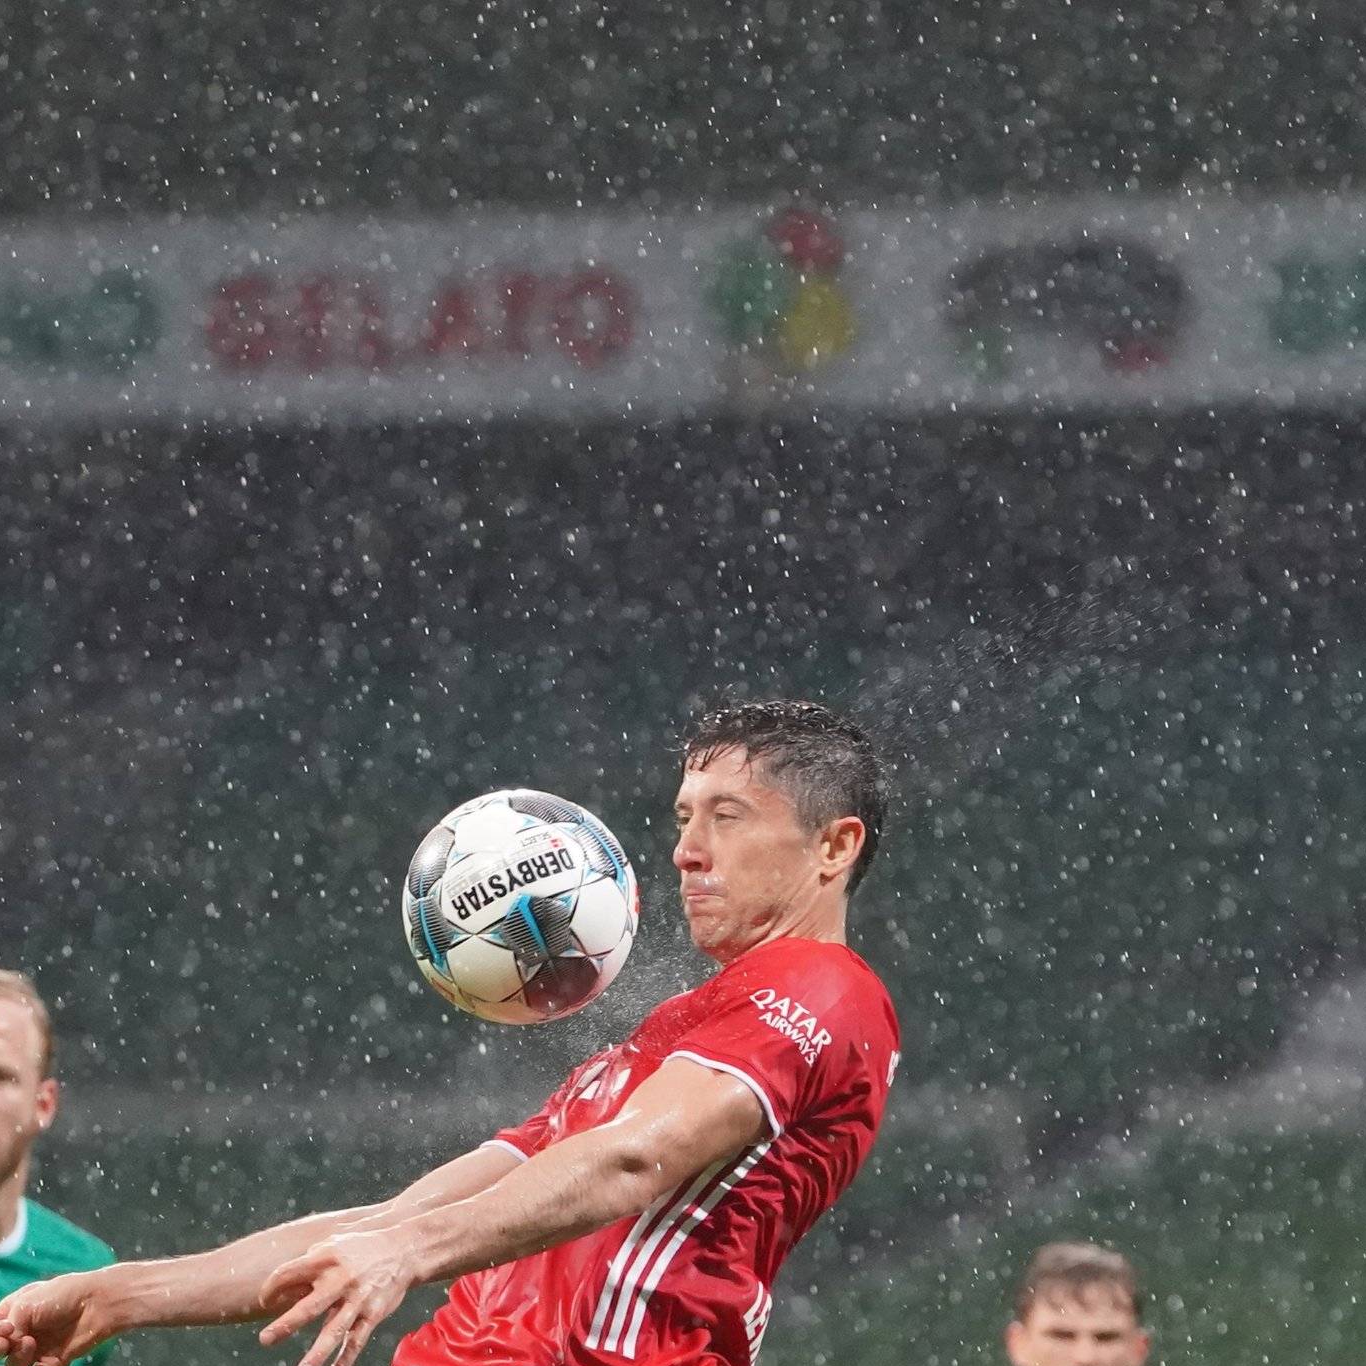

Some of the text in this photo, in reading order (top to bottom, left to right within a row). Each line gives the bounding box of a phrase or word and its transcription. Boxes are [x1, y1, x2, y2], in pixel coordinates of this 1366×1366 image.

[451, 848, 575, 920] DERBYSTAR
[749, 988, 833, 1054] QATAR
[758, 1011, 818, 1068] AIRWAYS
